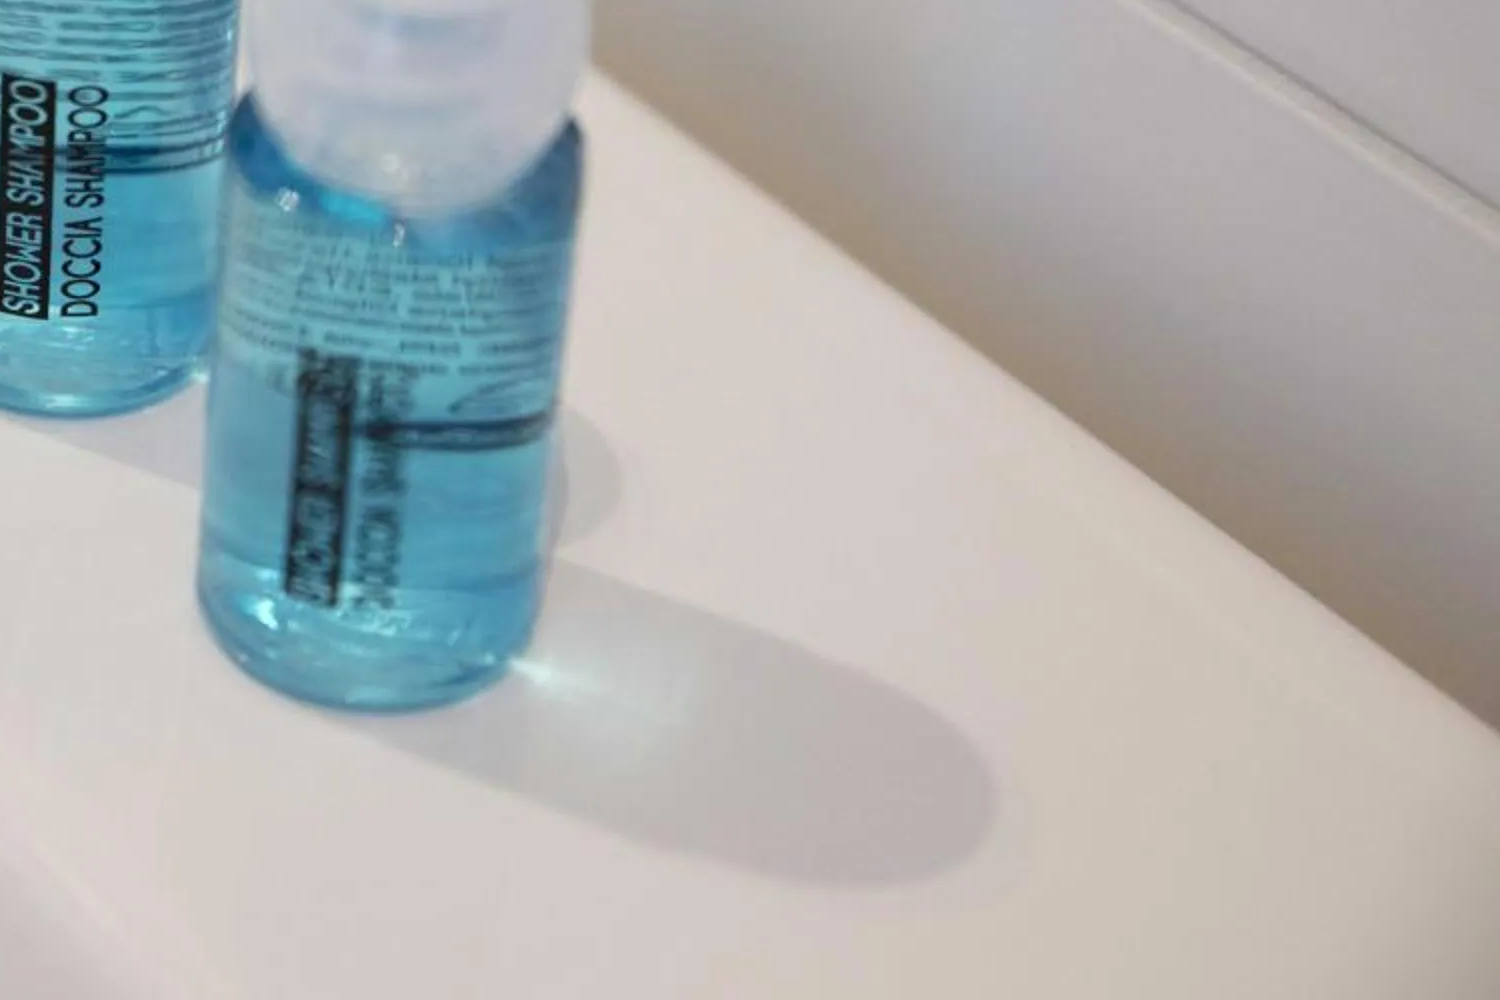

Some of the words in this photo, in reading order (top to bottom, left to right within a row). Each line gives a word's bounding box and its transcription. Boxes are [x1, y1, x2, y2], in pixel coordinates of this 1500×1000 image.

[5, 79, 49, 207] SHAMPOO
[64, 84, 109, 209] SHAMPOO
[1, 211, 45, 315] SHOWER
[59, 216, 104, 318] DOCCIA
